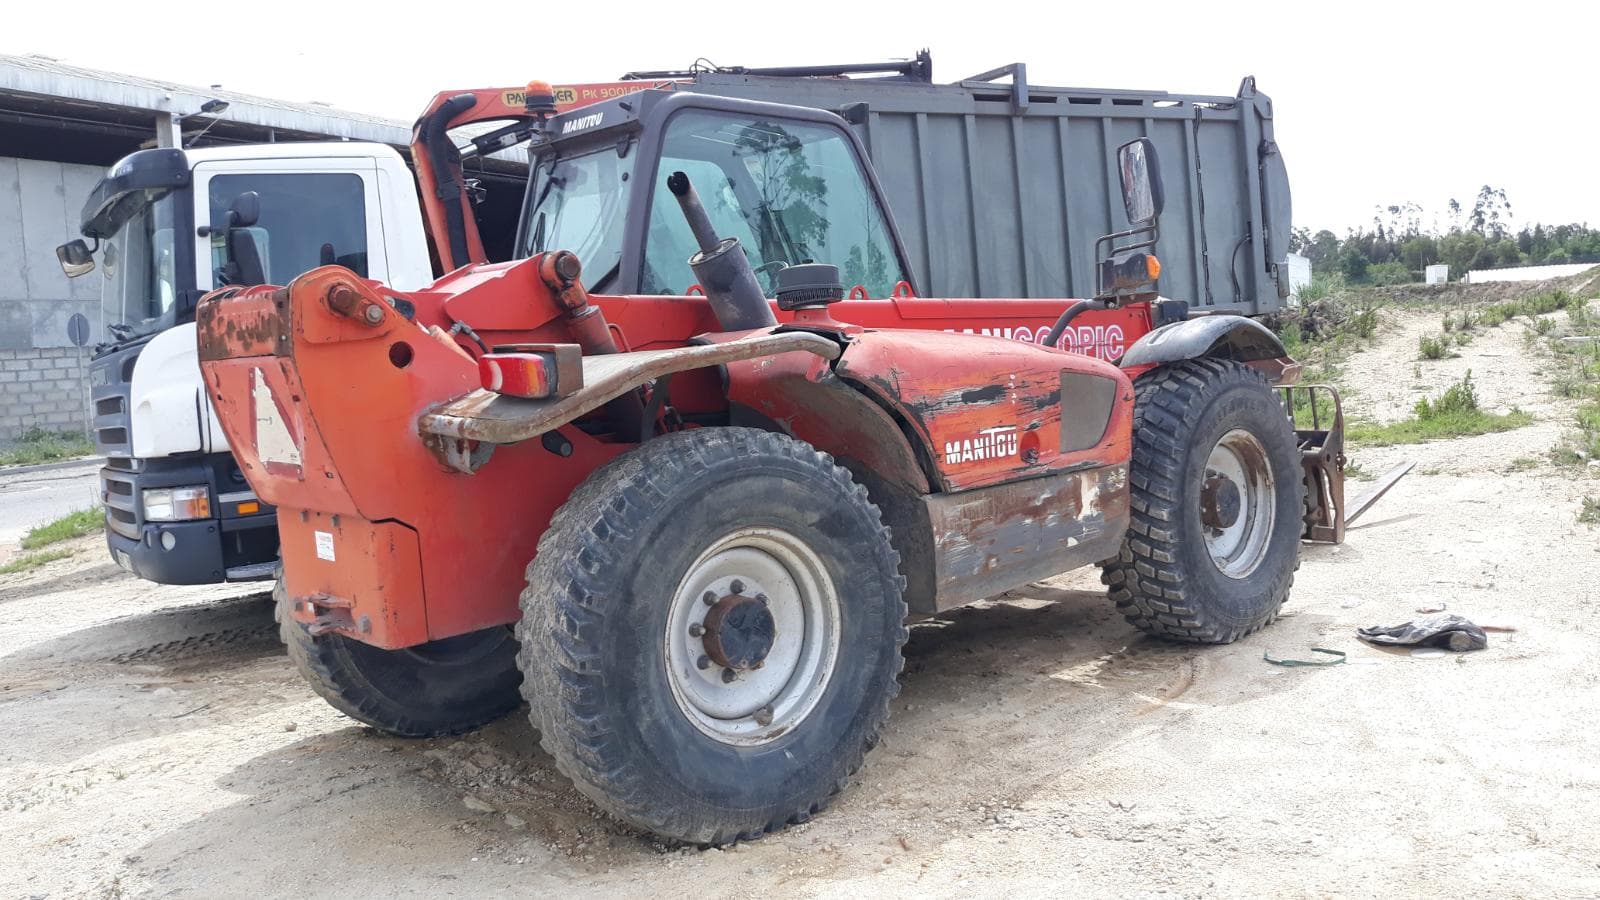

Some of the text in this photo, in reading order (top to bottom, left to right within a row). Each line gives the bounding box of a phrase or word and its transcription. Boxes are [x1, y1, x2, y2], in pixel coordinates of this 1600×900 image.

[582, 89, 598, 99] PK
[562, 112, 604, 134] MANITOU
[946, 426, 1017, 465] MANITOU
